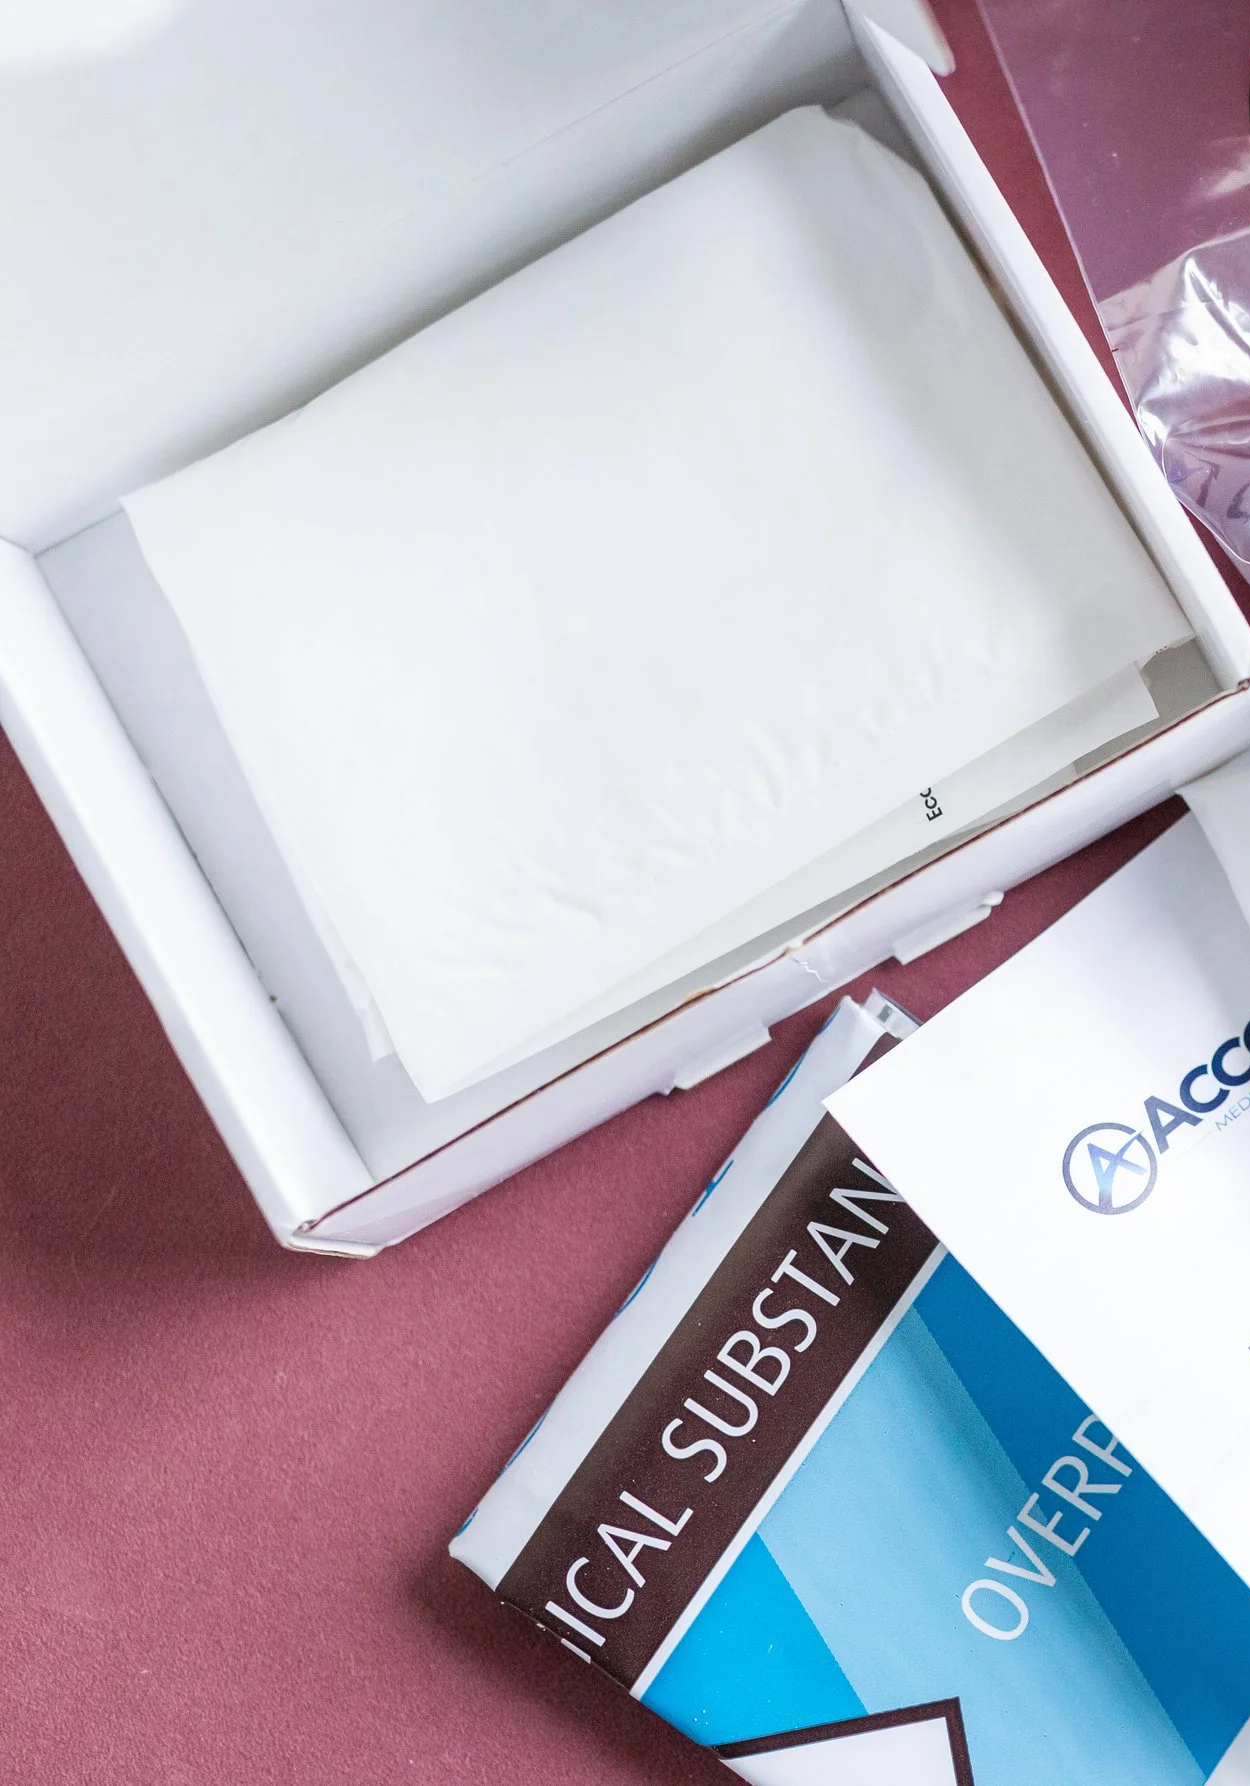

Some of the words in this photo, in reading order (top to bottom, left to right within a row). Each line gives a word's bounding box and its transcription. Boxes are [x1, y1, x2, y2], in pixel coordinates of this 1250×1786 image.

[545, 1489, 694, 1665] ICAL
[661, 1156, 908, 1484] SUBSTAN
[960, 1413, 1134, 1641] OVERP
